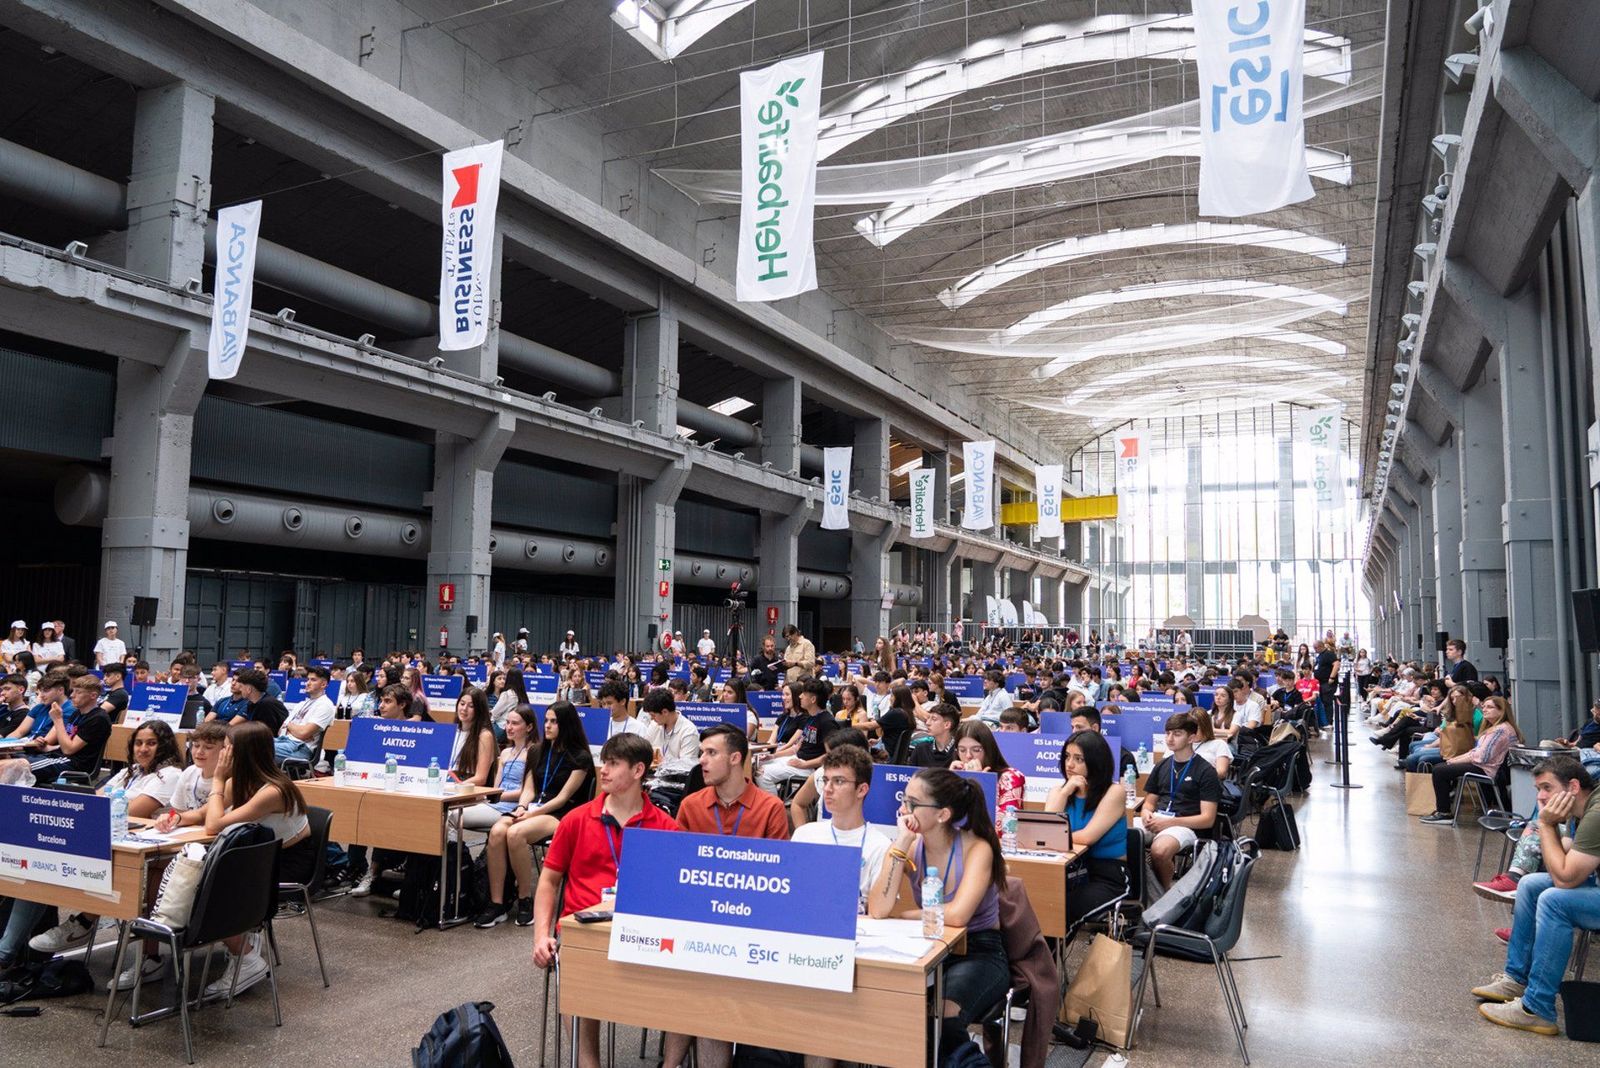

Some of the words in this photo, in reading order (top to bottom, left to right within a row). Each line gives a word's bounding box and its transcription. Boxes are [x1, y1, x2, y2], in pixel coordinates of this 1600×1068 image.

[374, 724, 391, 732] Colegio
[382, 738, 416, 748] LAKTICUS
[886, 773, 897, 782] IES
[31, 796, 50, 806] Corbera
[52, 799, 58, 807] de
[59, 799, 84, 811] Llobregat
[29, 813, 74, 829] PETITSUISSE
[37, 833, 66, 845] Barcelona
[698, 845, 714, 858] IES
[716, 846, 780, 864] Consaburun
[80, 870, 104, 880] Herbalife
[679, 868, 791, 894] DESLECHADOS
[710, 900, 752, 916] Toledo
[620, 934, 660, 946] BUSINESS
[788, 953, 838, 970] Herbalife
